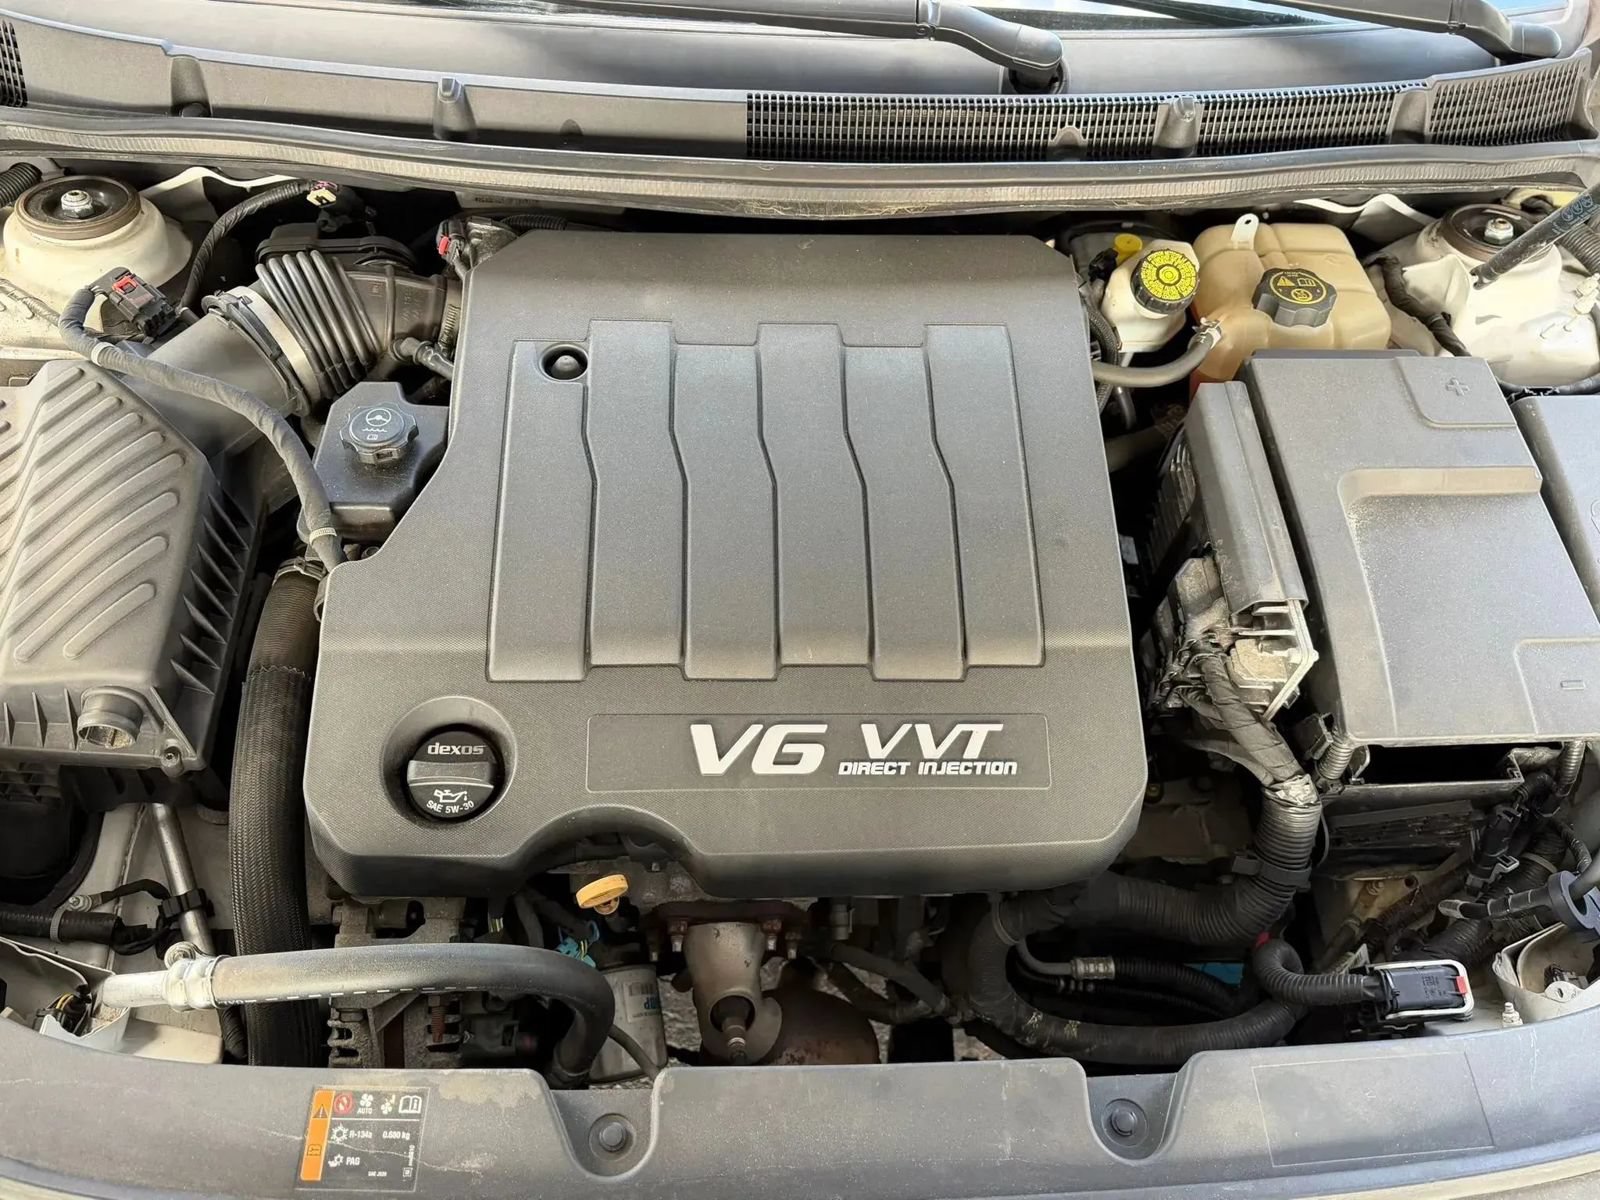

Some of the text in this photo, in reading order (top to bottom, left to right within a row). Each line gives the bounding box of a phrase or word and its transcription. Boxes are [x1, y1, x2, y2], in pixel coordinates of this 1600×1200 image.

[427, 742, 486, 755] dexos
[690, 723, 1004, 776] V6 VVT
[838, 761, 1018, 775] DIRECT INJECTION
[426, 800, 475, 814] SAE 5W-30
[357, 1107, 372, 1115] AUTO
[346, 1157, 360, 1166] PAG
